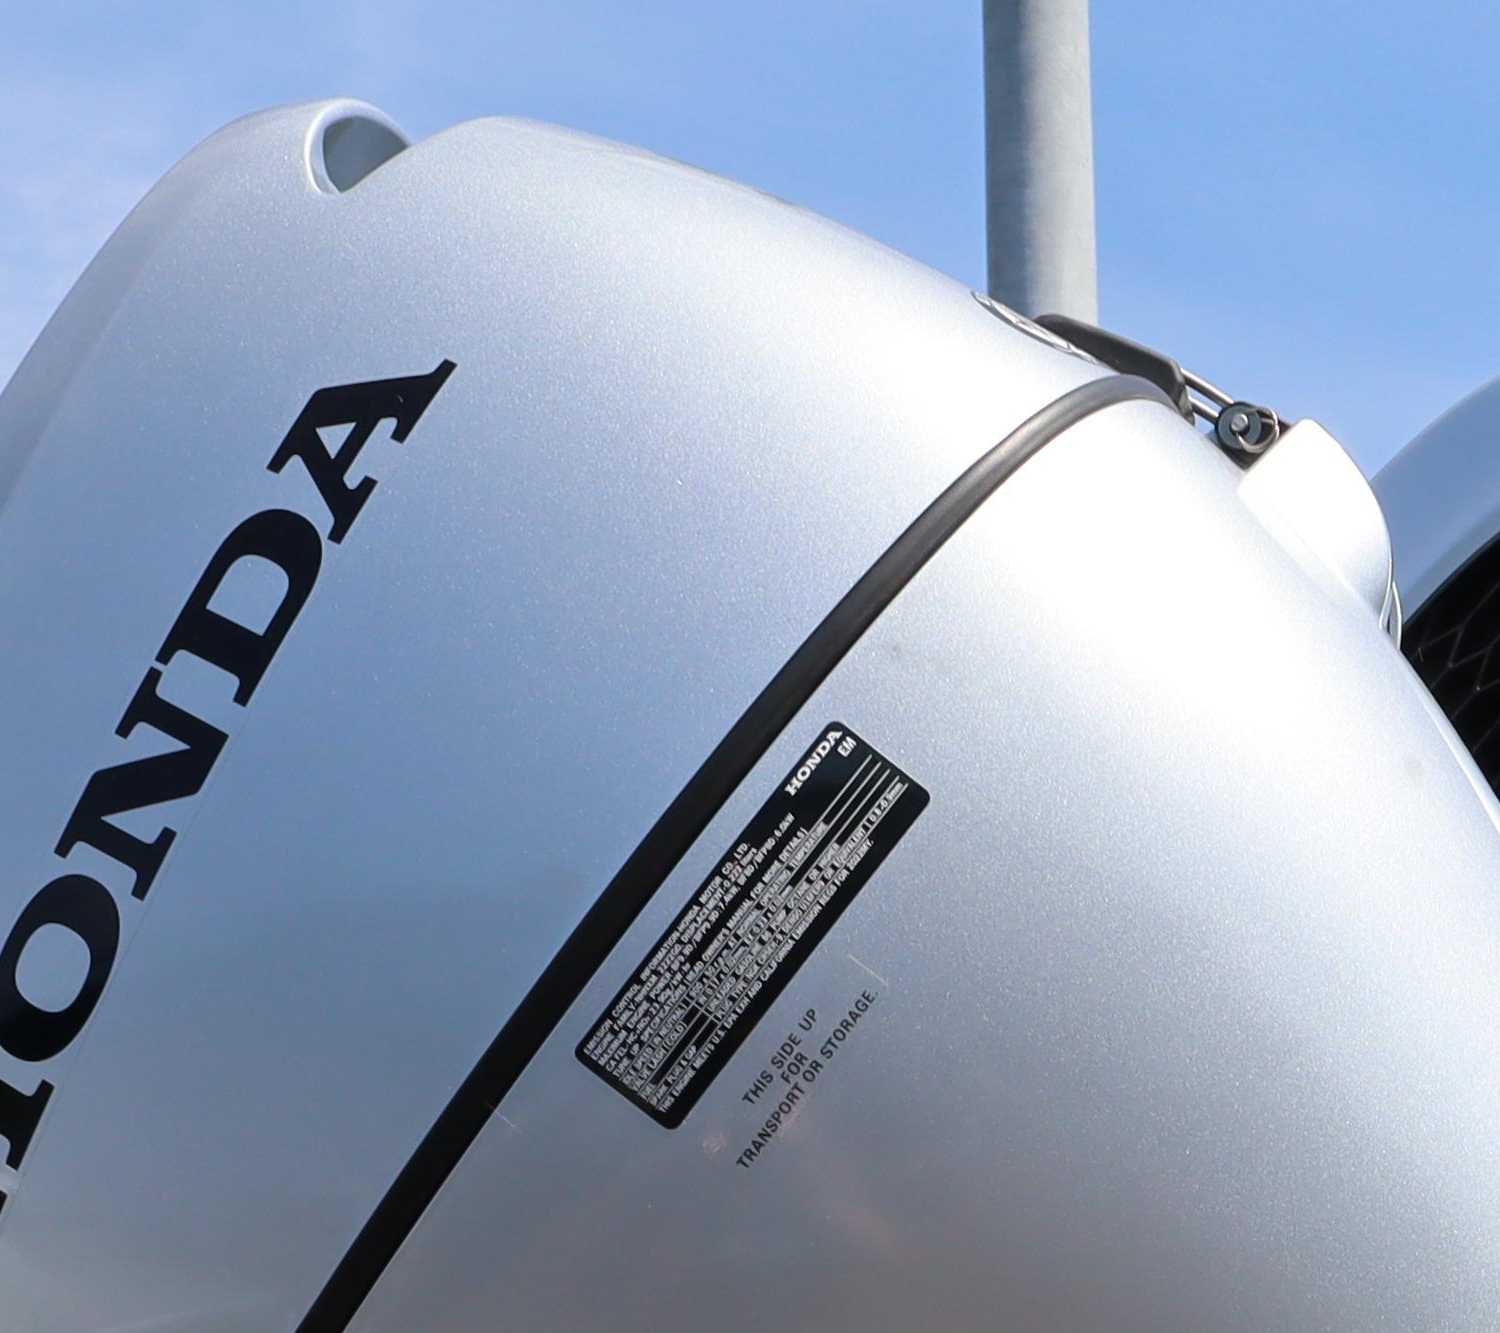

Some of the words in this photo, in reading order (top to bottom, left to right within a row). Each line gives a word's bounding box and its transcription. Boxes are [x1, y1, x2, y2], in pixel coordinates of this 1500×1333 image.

[783, 724, 843, 797] HONDA
[835, 735, 857, 758] EM
[610, 981, 641, 1018] CONTROL
[697, 874, 723, 904] MOTOR
[741, 1068, 775, 1107] THIS
[768, 1031, 802, 1070] SIDE
[796, 1006, 821, 1032] UP
[778, 1050, 810, 1085] FOR
[735, 1081, 807, 1171] TRANSPORT
[799, 1058, 824, 1084] OR
